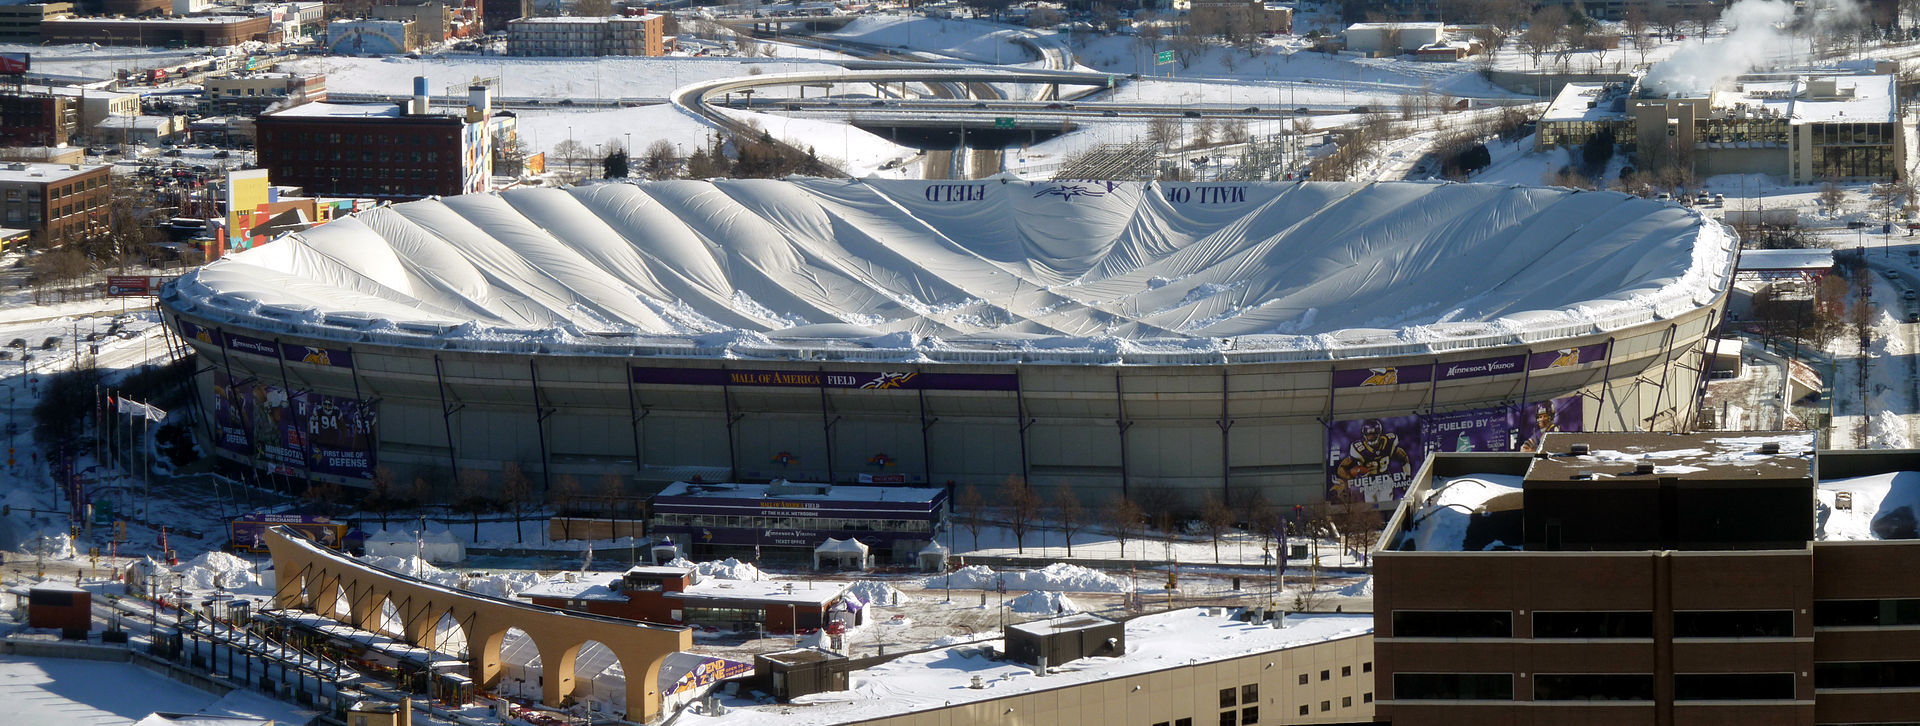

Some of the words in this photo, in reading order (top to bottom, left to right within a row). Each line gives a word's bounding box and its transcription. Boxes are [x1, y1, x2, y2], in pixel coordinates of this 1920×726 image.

[925, 184, 985, 202] FIELD
[1167, 187, 1191, 204] OF
[1196, 186, 1247, 203] MALL
[731, 373, 757, 384] MALL
[758, 373, 771, 384] OF
[773, 371, 821, 385] AMERICA
[827, 375, 857, 385] FIELD
[298, 401, 306, 416] H
[309, 420, 319, 434] H
[321, 415, 338, 430] 94
[1438, 420, 1474, 432] FUELED
[1476, 418, 1488, 428] BY
[329, 457, 367, 468] DEFENSE
[355, 451, 364, 459] OF
[1330, 450, 1340, 466] F
[1347, 474, 1390, 488] FUELED
[705, 659, 725, 674] END
[725, 665, 738, 673] OPEN
[700, 668, 726, 685] ZNE
